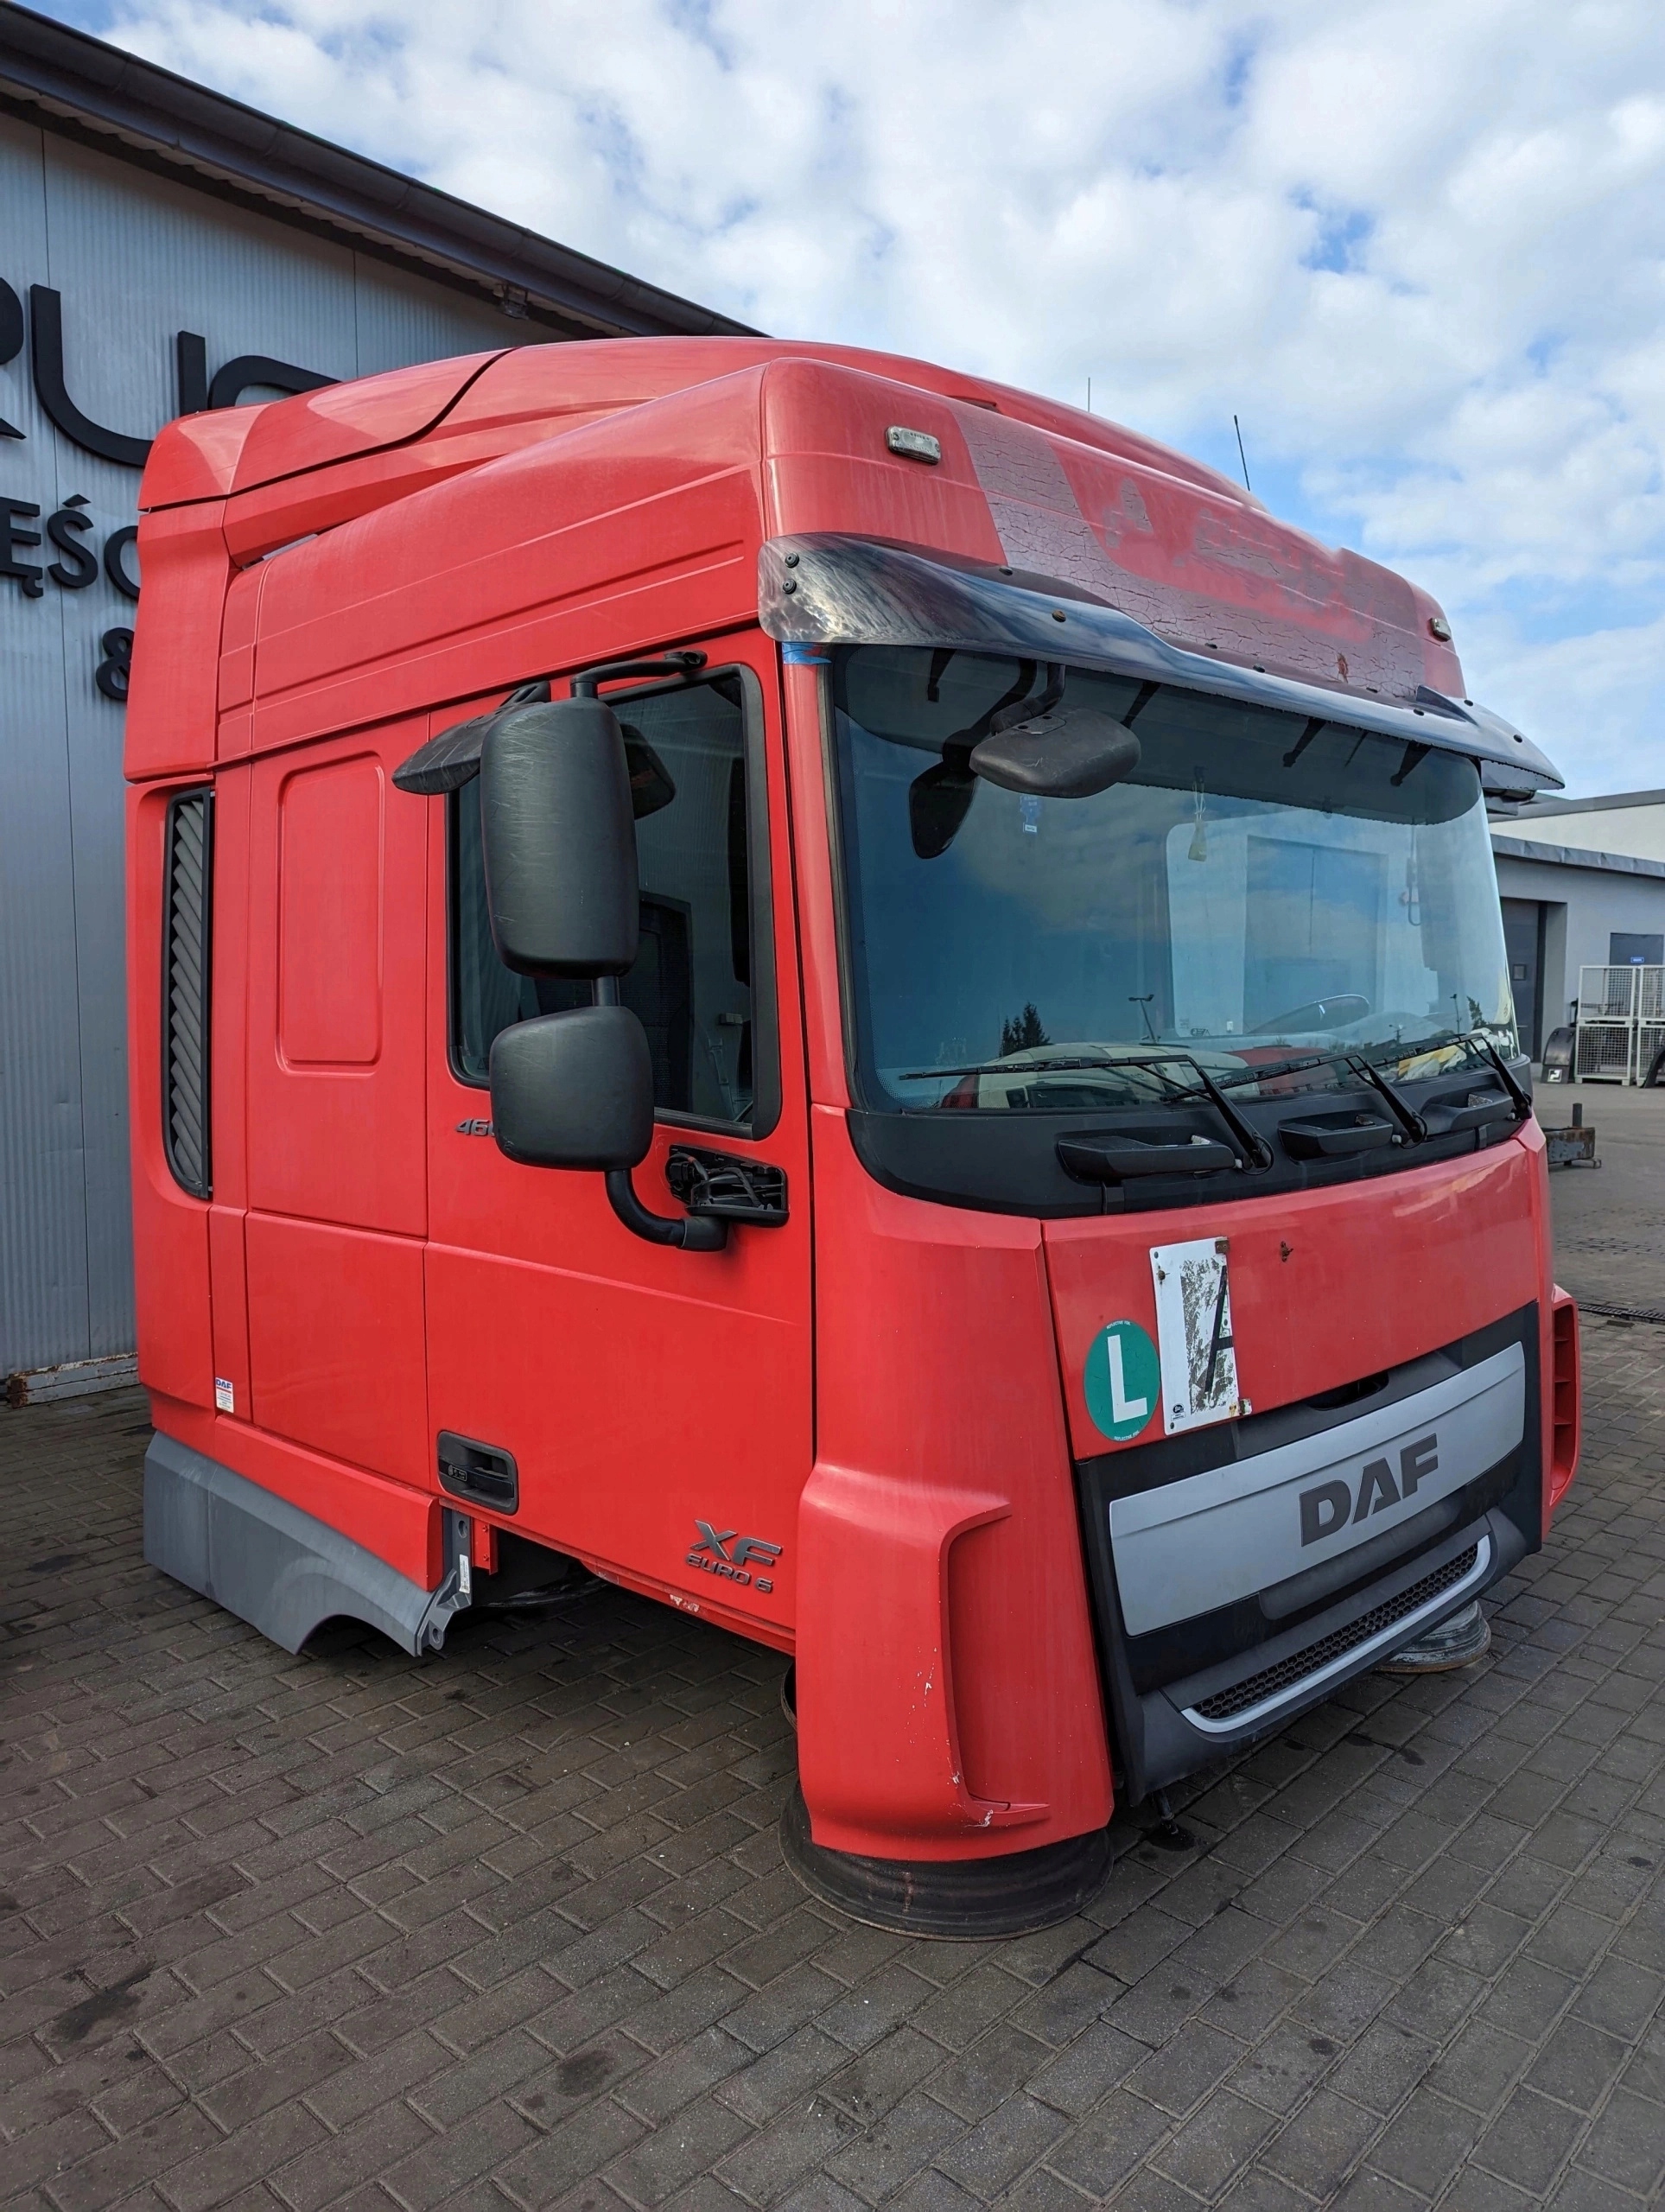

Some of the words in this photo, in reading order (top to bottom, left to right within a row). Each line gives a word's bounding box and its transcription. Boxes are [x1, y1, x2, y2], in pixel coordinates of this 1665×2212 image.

[215, 1378, 232, 1389] DAF
[1107, 1334, 1147, 1424] L
[1299, 1433, 1439, 1547] DAF
[690, 1519, 783, 1566] XF
[686, 1553, 751, 1586] EURO
[754, 1577, 774, 1594] 6
